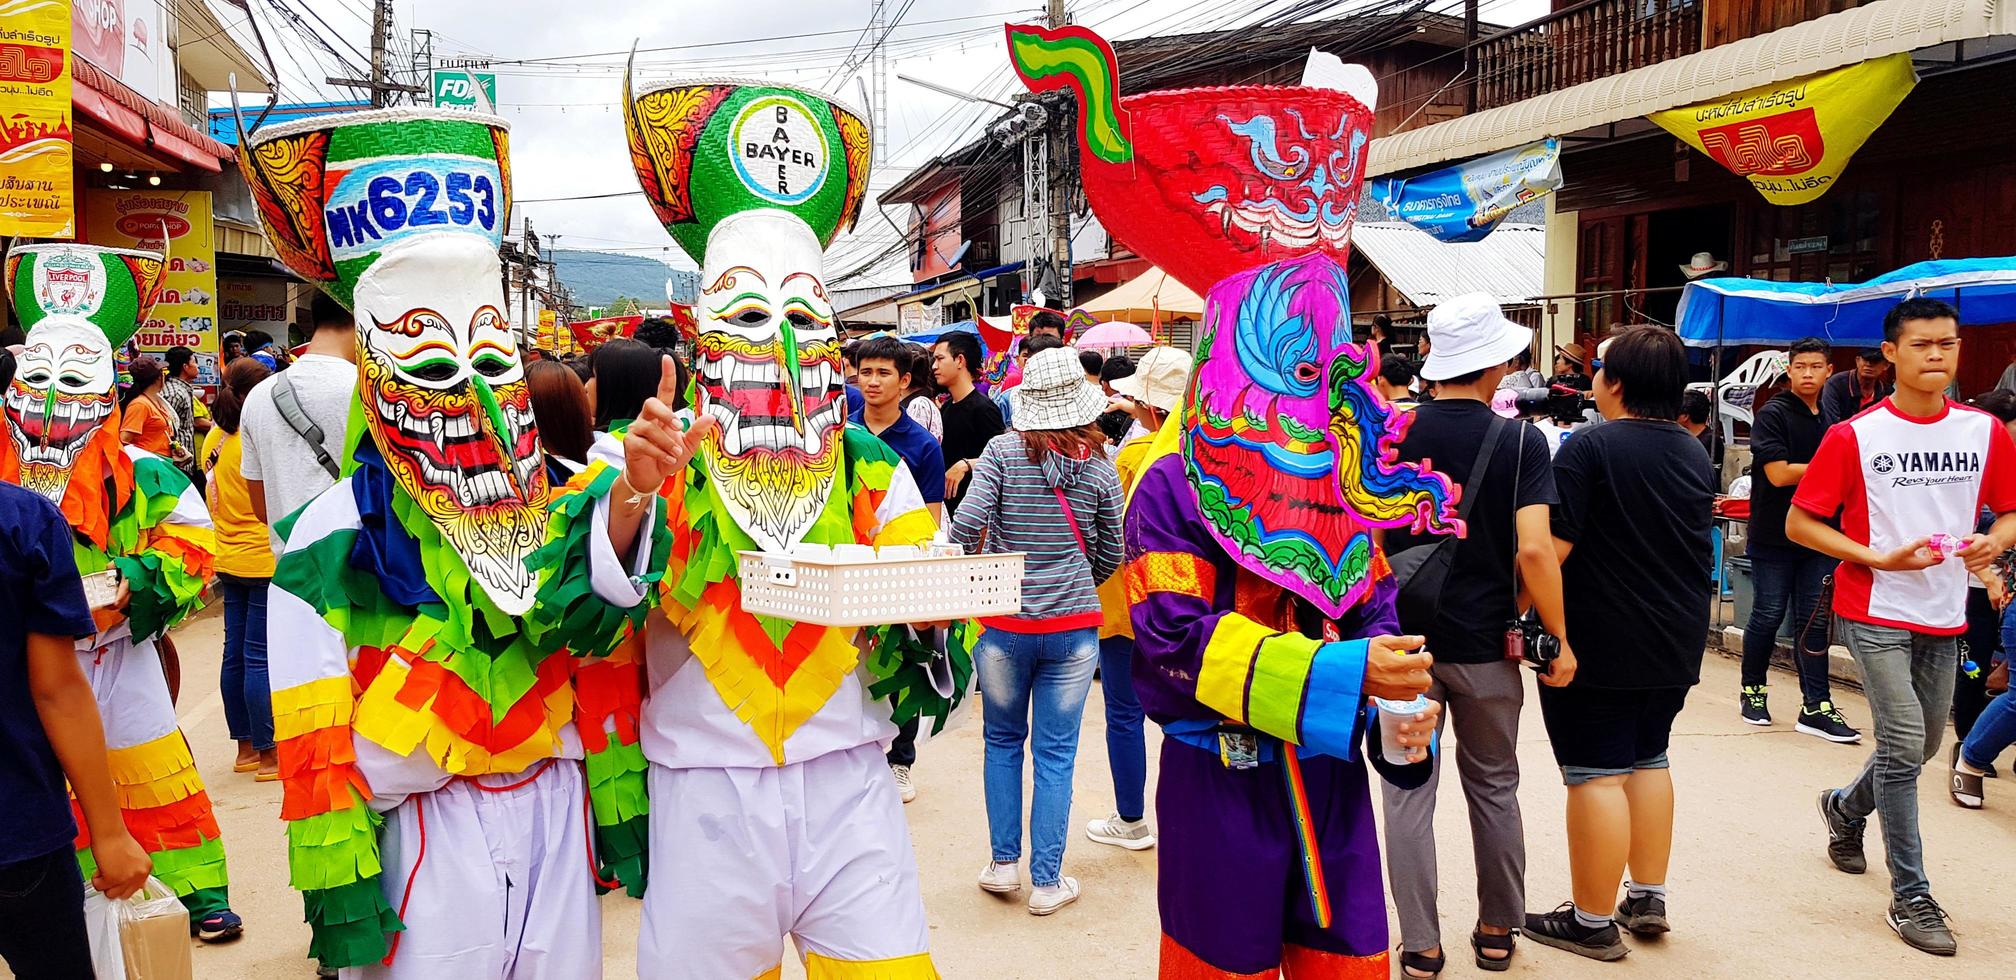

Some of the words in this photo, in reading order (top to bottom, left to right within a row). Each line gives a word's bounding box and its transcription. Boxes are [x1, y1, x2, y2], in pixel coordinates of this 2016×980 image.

[746, 142, 816, 169] BAYER
[772, 106, 790, 195] BAYER
[49, 273, 87, 282] LIVERPOOL
[1505, 400, 1514, 409] M
[1896, 451, 1979, 472] YAMAHA
